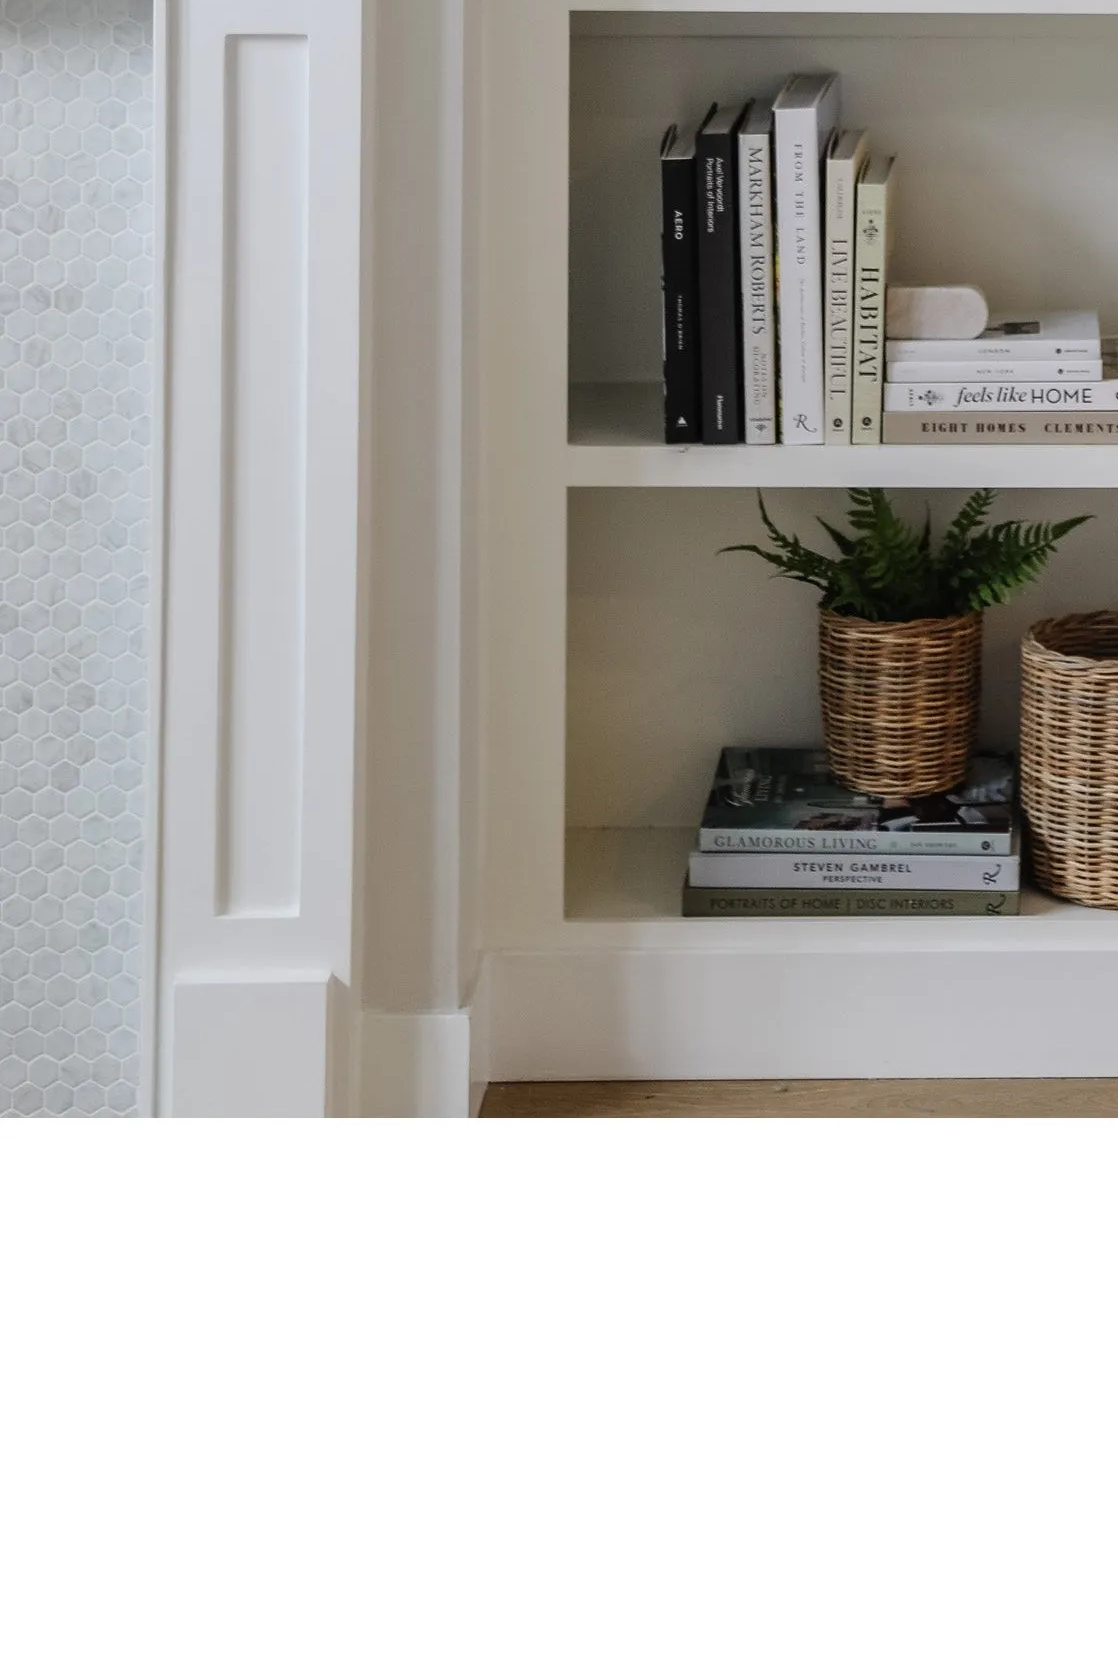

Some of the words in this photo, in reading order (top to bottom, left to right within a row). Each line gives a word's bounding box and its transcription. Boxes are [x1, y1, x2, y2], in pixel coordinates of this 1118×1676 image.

[706, 158, 716, 190] Portraits
[715, 157, 725, 175] Axel
[793, 143, 805, 183] FROM
[706, 191, 716, 200] of
[748, 147, 765, 248] MARKHAM
[795, 191, 806, 219] THE
[674, 210, 684, 241] AERO
[706, 201, 716, 233] Interiors
[796, 227, 806, 266] LAND
[830, 239, 849, 283] LIVE
[751, 254, 768, 335] ROBERTS
[859, 266, 880, 383] HABITAT
[953, 386, 993, 408] feels
[997, 385, 1027, 403] like
[1031, 388, 1093, 405] HOME
[921, 422, 969, 433] EIGHT
[975, 423, 1027, 434] HOMES
[714, 835, 816, 850] GLAMOROUS
[821, 836, 877, 851] LIVING
[793, 862, 844, 873] STEVEN
[850, 862, 912, 873] GAMBREL
[822, 875, 883, 884] PERSPECTIVE
[710, 898, 775, 911] PORTRAITS
[779, 898, 798, 911] OF
[802, 898, 841, 911] HOME
[856, 898, 887, 911] DISC
[890, 898, 955, 911] INTERIORS
